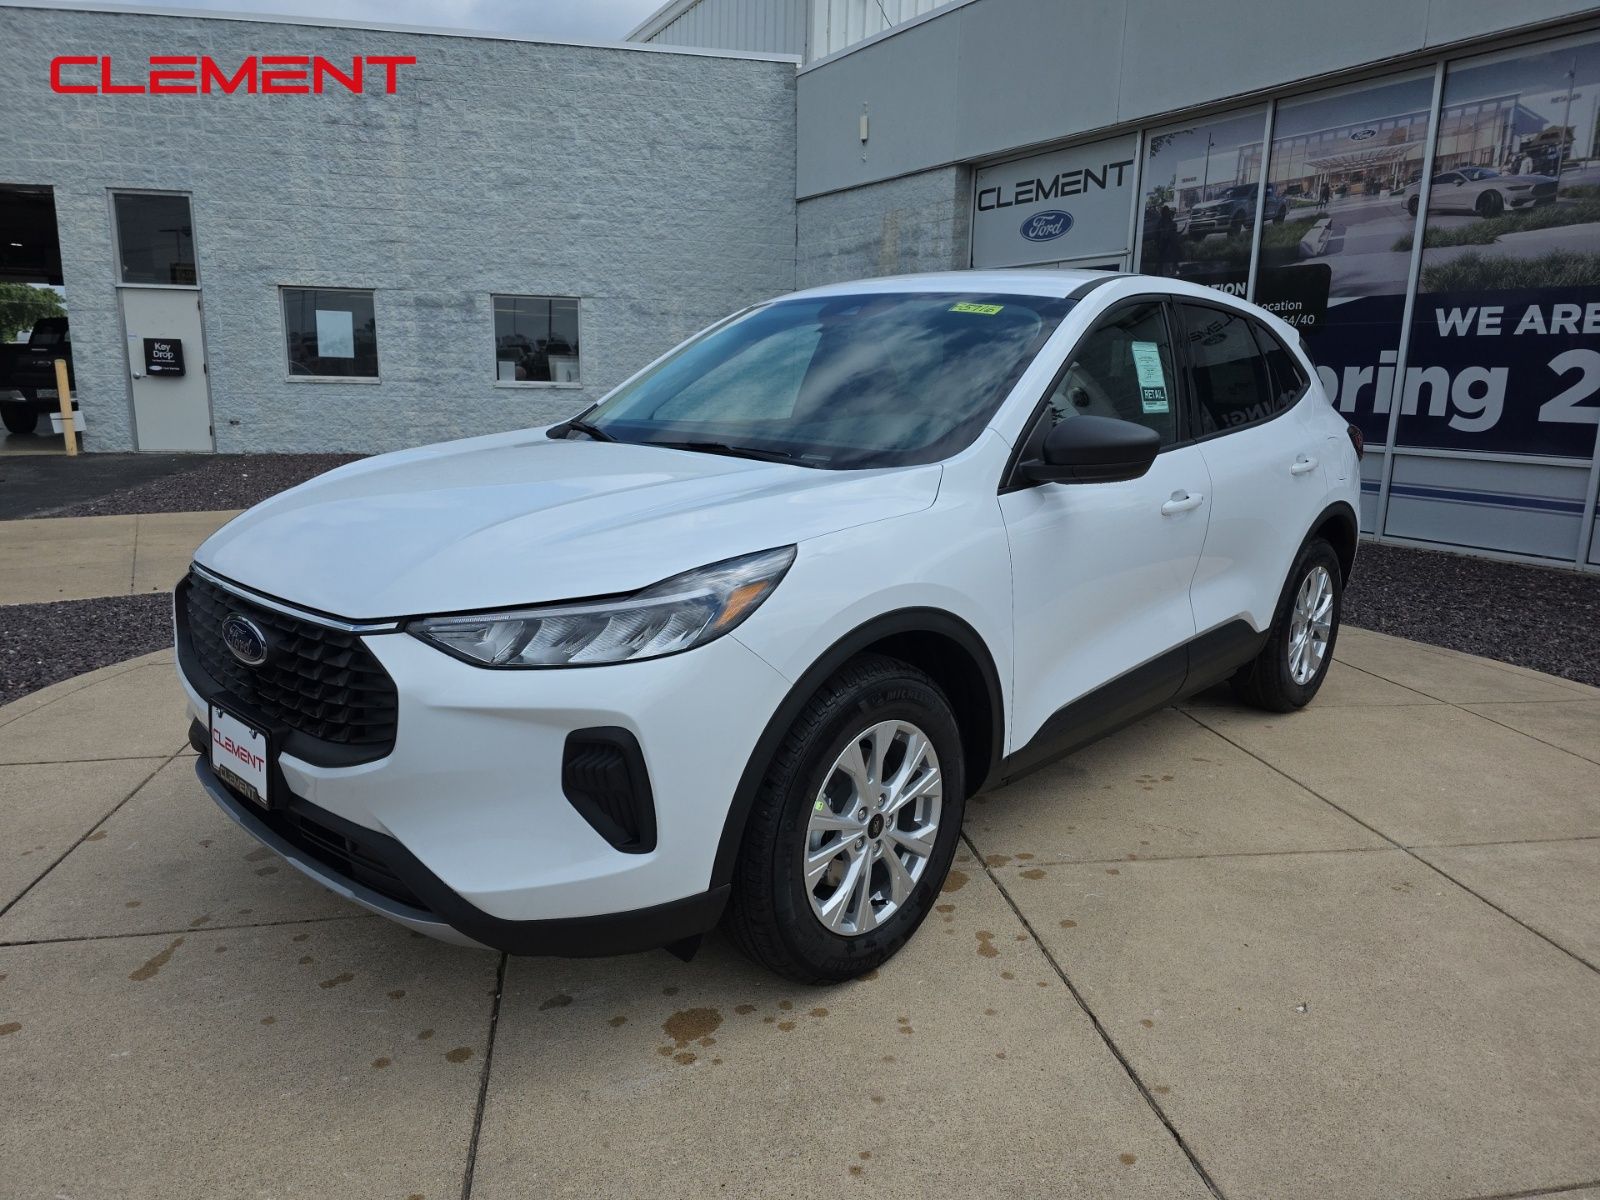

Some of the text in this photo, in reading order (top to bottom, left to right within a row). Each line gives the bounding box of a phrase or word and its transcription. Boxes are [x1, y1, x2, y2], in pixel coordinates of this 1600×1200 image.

[978, 159, 1134, 211] CLEMENT
[1028, 214, 1063, 238] Ford
[1256, 300, 1302, 312] ocation
[1436, 303, 1600, 337] WE ARE
[153, 350, 174, 360] Drop
[154, 342, 171, 352] Key
[212, 728, 265, 773] CLEMENT
[220, 766, 257, 799] CLEMENT
